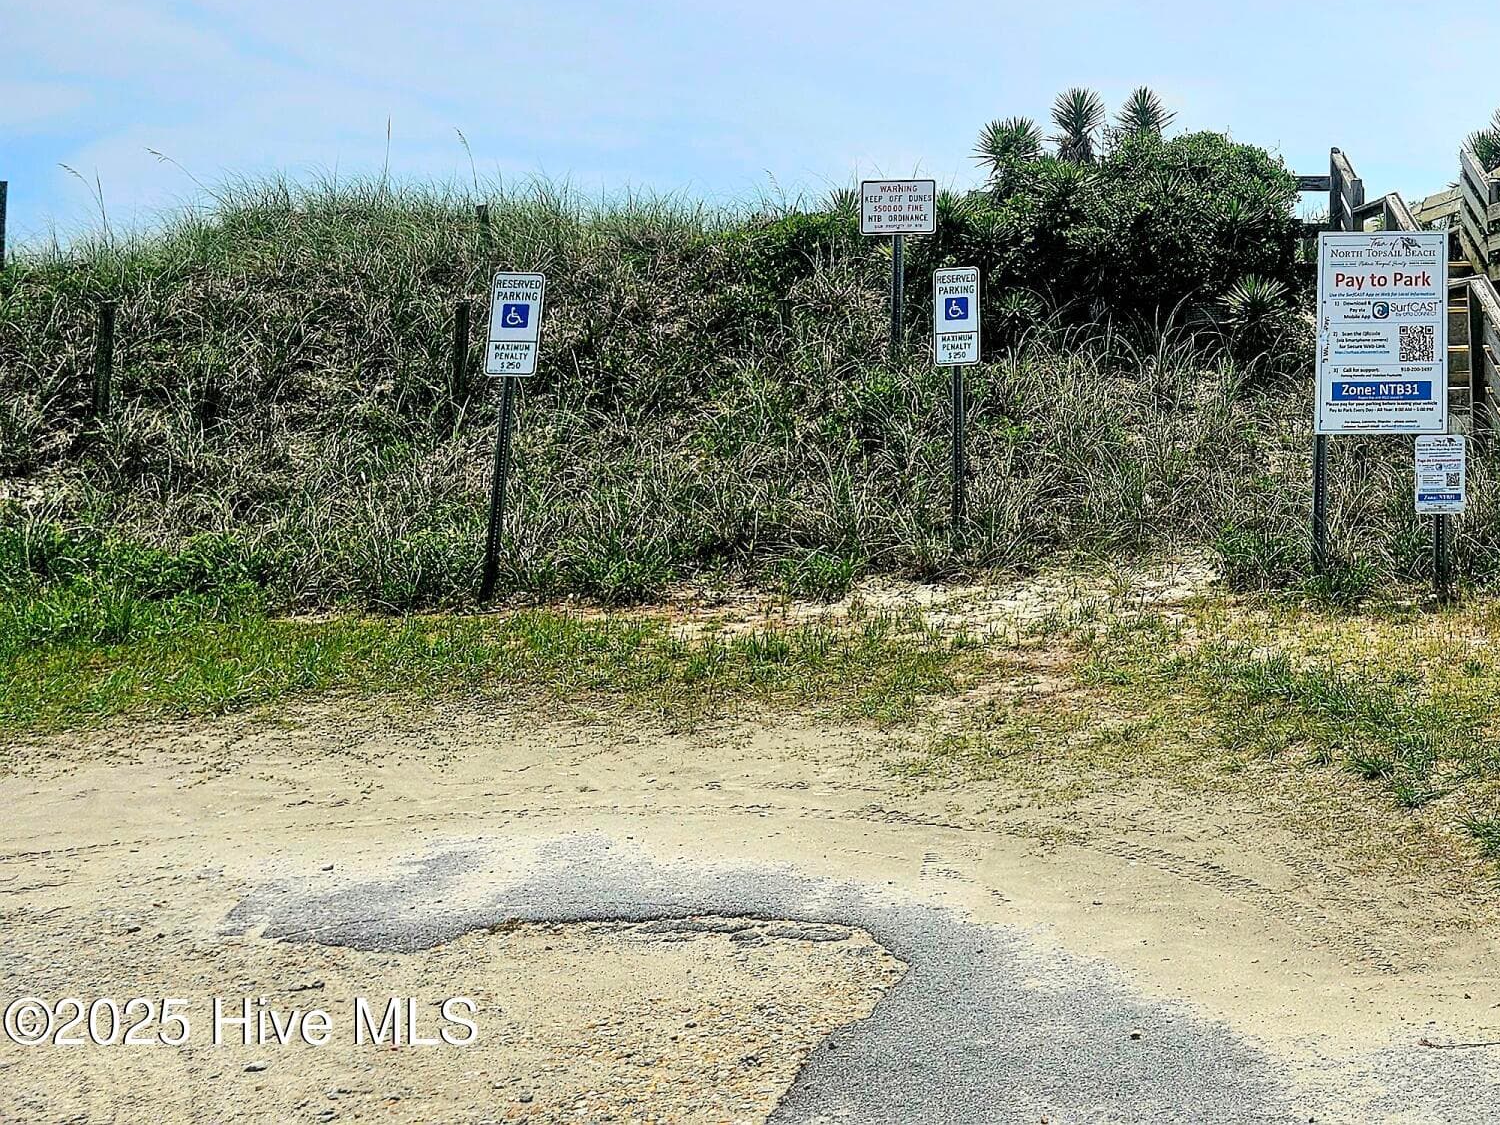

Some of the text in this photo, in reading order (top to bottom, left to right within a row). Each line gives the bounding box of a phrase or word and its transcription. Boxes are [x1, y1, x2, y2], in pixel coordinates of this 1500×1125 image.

[880, 185, 918, 193] WARNING
[865, 195, 882, 203] KEEP
[888, 214, 928, 222] ORDINANCE
[1330, 249, 1362, 258] NORTH
[1366, 249, 1402, 257] TOPSAIL
[937, 274, 975, 284] RESERVED
[1335, 271, 1431, 290] Pay to Park
[496, 280, 540, 289] RESERVED
[938, 285, 974, 295] PARKING
[497, 292, 538, 301] PARKING
[1391, 302, 1438, 312] SurfCAST
[500, 361, 520, 369] $250
[1342, 384, 1420, 395] Zone: NTB31
